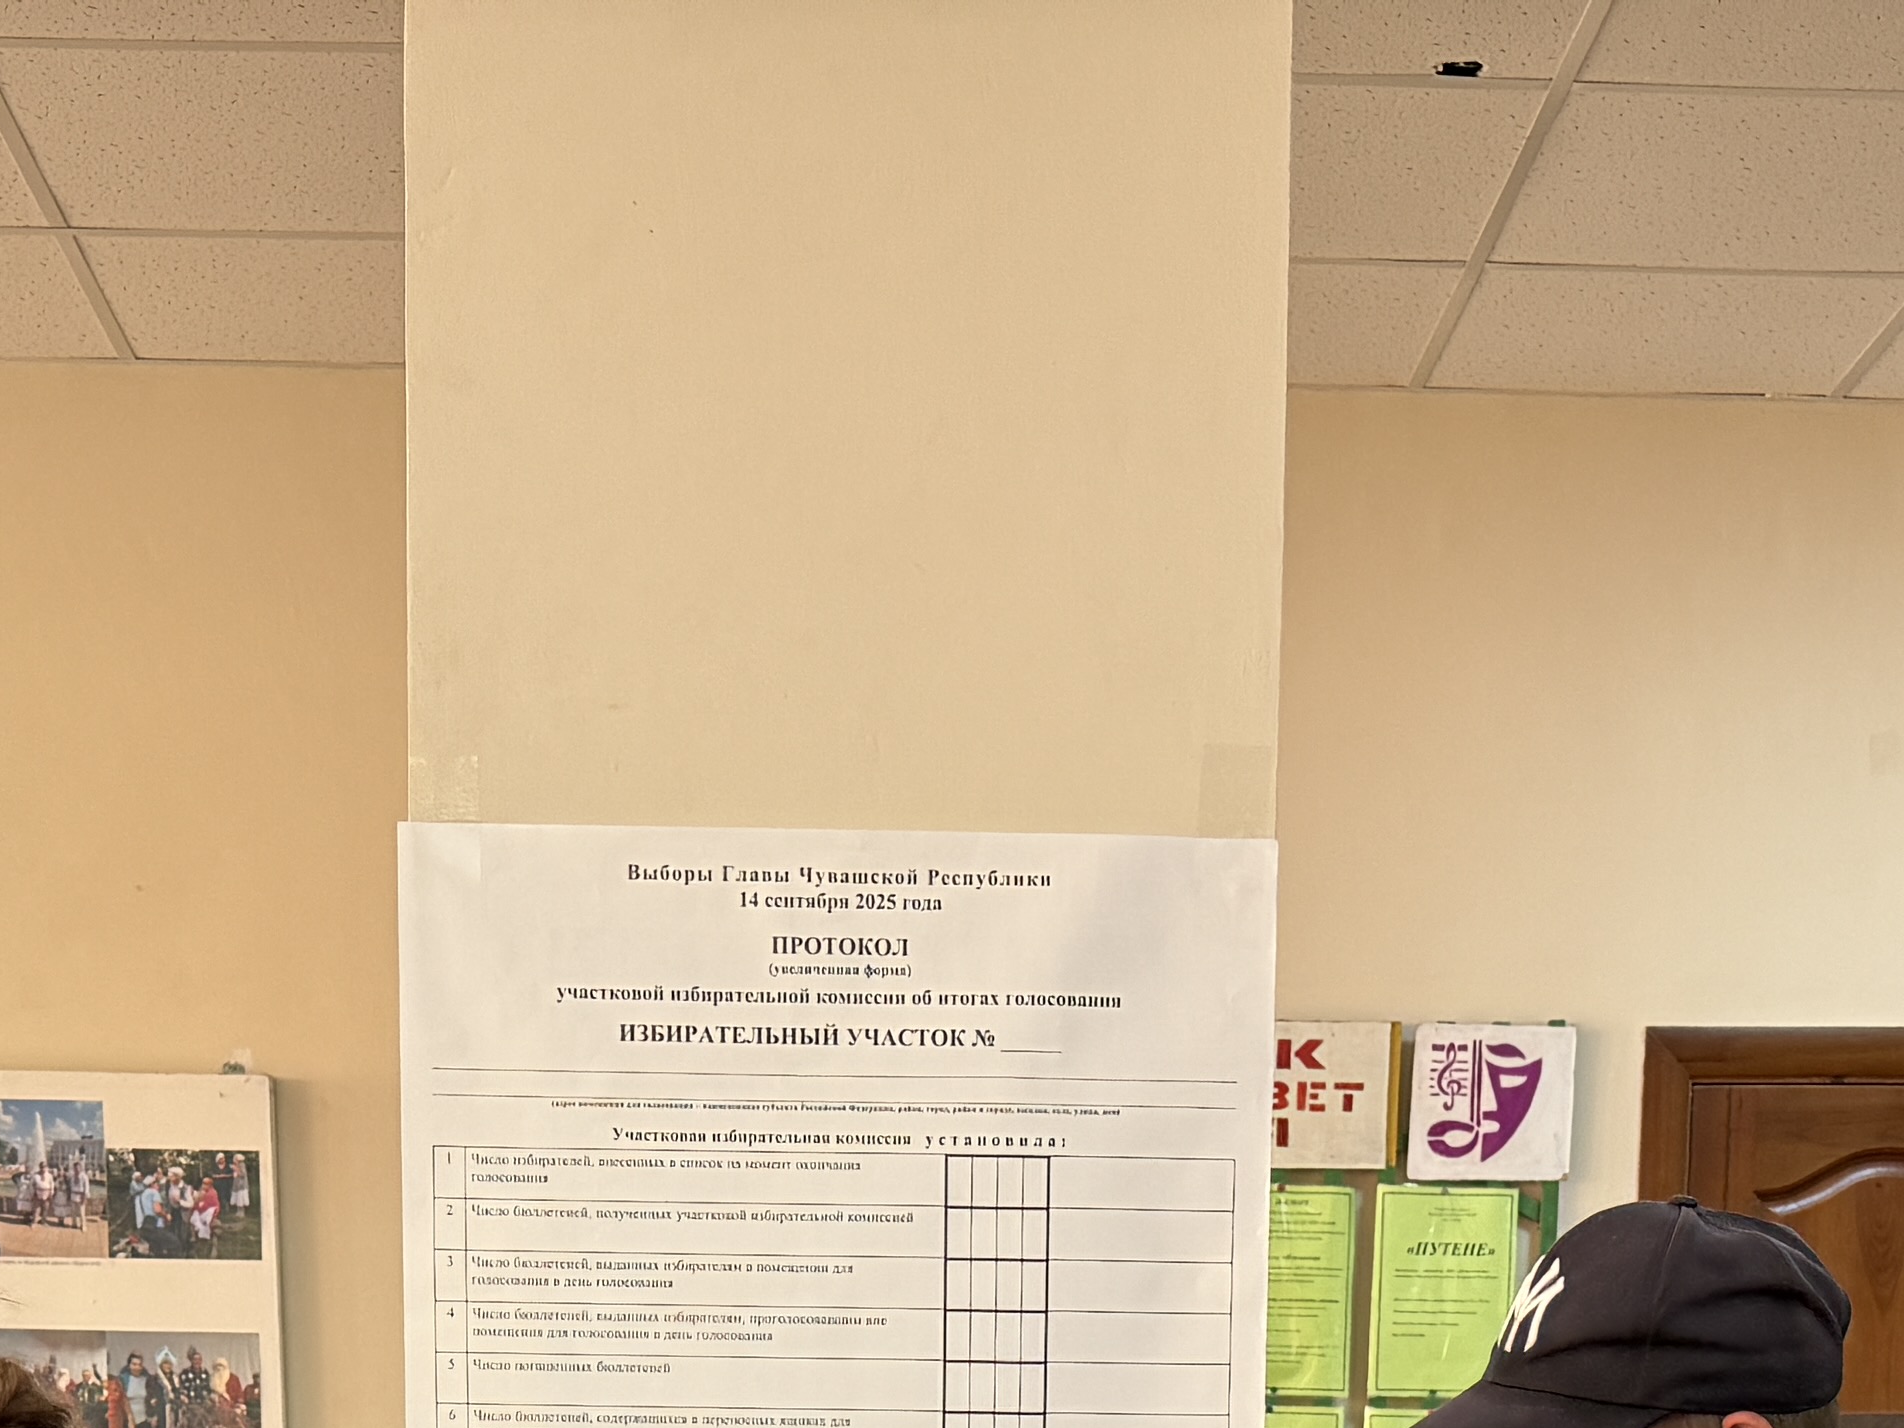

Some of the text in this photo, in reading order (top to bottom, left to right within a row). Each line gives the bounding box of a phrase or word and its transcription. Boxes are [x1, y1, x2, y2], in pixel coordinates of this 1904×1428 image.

[629, 864, 1050, 890] Выборы Главы Чувашской Республики
[741, 891, 942, 914] 14 сентября 2025 года
[773, 936, 908, 957] ПРОТОКОЛ
[769, 963, 911, 979] (увеличенная форма)
[557, 985, 1120, 1008] участковой избирательной комиссии об итогах голосования
[620, 1023, 995, 1047] ИЗБИРАТЕЛЬНЫЙ УЧАСТОК №
[613, 1127, 706, 1143] Участковая
[713, 1128, 830, 1148] избирательная
[836, 1134, 910, 1146] комиссия
[448, 1152, 450, 1164] 1
[472, 1153, 509, 1165] Число
[447, 1205, 453, 1215] 2
[472, 1203, 509, 1217] Число
[448, 1256, 453, 1266] 3
[472, 1255, 510, 1268] Число
[447, 1308, 454, 1317] 4
[473, 1307, 510, 1320] Число
[448, 1359, 454, 1369] 5
[473, 1358, 510, 1371] Число
[449, 1409, 456, 1420] 6
[474, 1409, 511, 1422] Число
